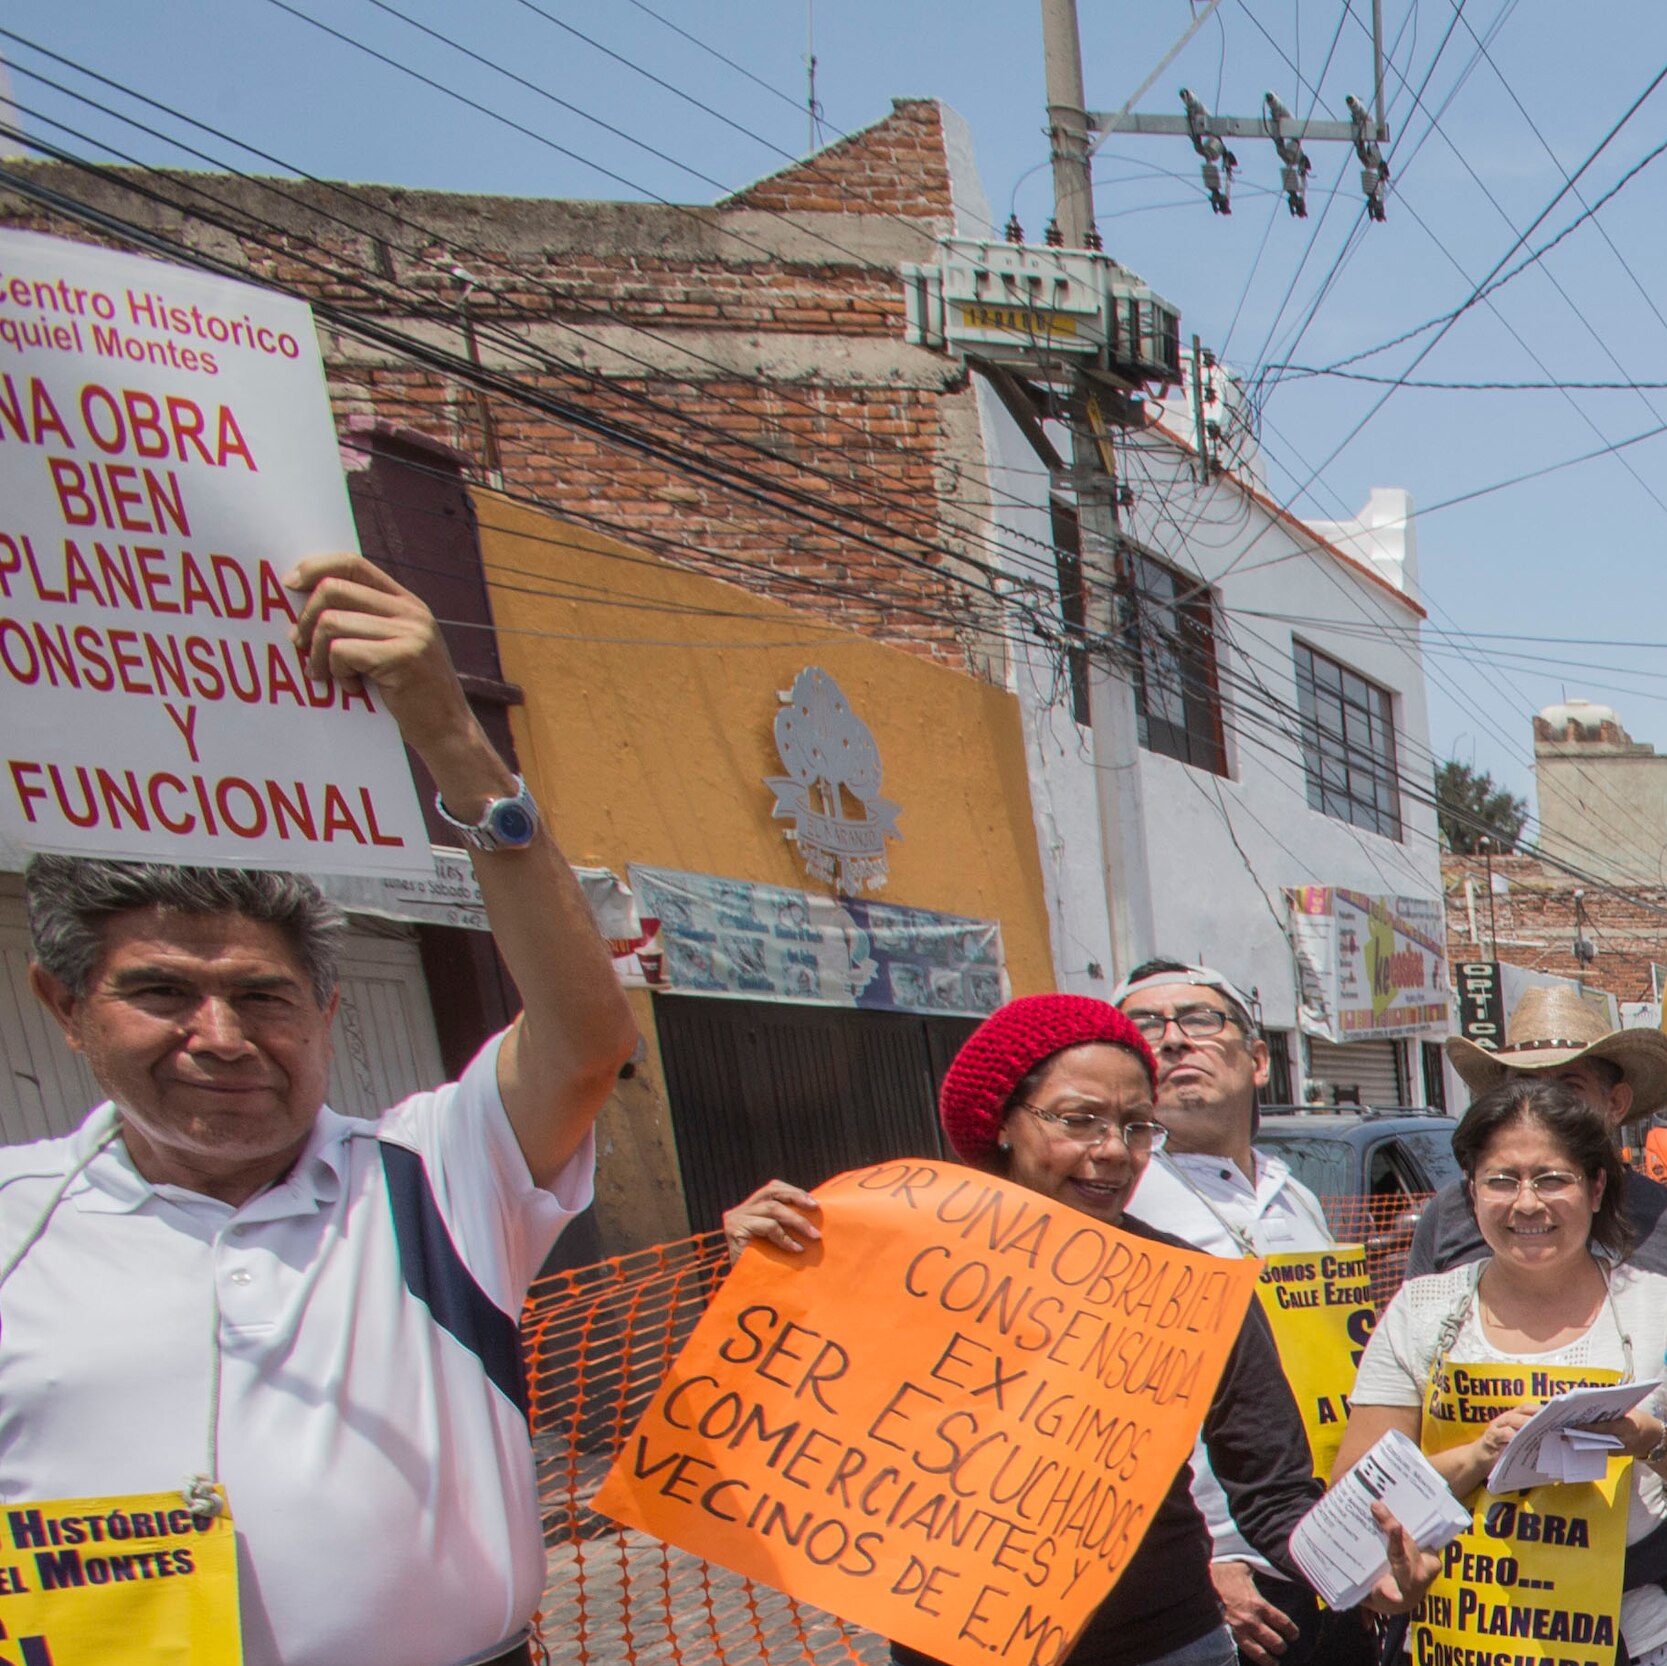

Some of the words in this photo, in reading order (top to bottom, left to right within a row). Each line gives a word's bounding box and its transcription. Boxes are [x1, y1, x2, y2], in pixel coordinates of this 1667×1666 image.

[0, 271, 116, 320] entro
[126, 289, 300, 359] Historico
[0, 316, 83, 353] quiel
[92, 324, 219, 375] Montes
[0, 373, 76, 450] NA
[81, 384, 259, 472] OBRA
[48, 457, 192, 537] BIEN
[0, 533, 298, 624] PLANEADA
[0, 617, 377, 714] ONSENSUAD
[164, 703, 200, 763] Y
[8, 760, 405, 848] FUNCIONAL
[937, 1180, 1052, 1270] UNA
[1051, 1228, 1169, 1319] OBRA
[1321, 1256, 1368, 1280] CENT
[905, 1246, 1205, 1409] CONSENSUADA
[1276, 1285, 1320, 1310] CALLE
[1324, 1282, 1371, 1306] EZEQU
[719, 1305, 852, 1415] SER
[1454, 1370, 1525, 1397] CENTRO
[930, 1332, 1154, 1482] EXIGIMOS
[663, 1376, 1059, 1588] COMERCIANTES
[868, 1381, 1147, 1575] ESCUCHADOS
[7, 1508, 216, 1550] HISTÓRICO
[633, 1436, 886, 1579] VECINOS
[890, 1555, 961, 1619] DE
[1445, 1540, 1555, 1591] PERO...
[1484, 1501, 1590, 1548] OBRA
[34, 1548, 197, 1591] MONTES
[1059, 1559, 1092, 1602] Y
[1459, 1593, 1615, 1648] PLANEADA
